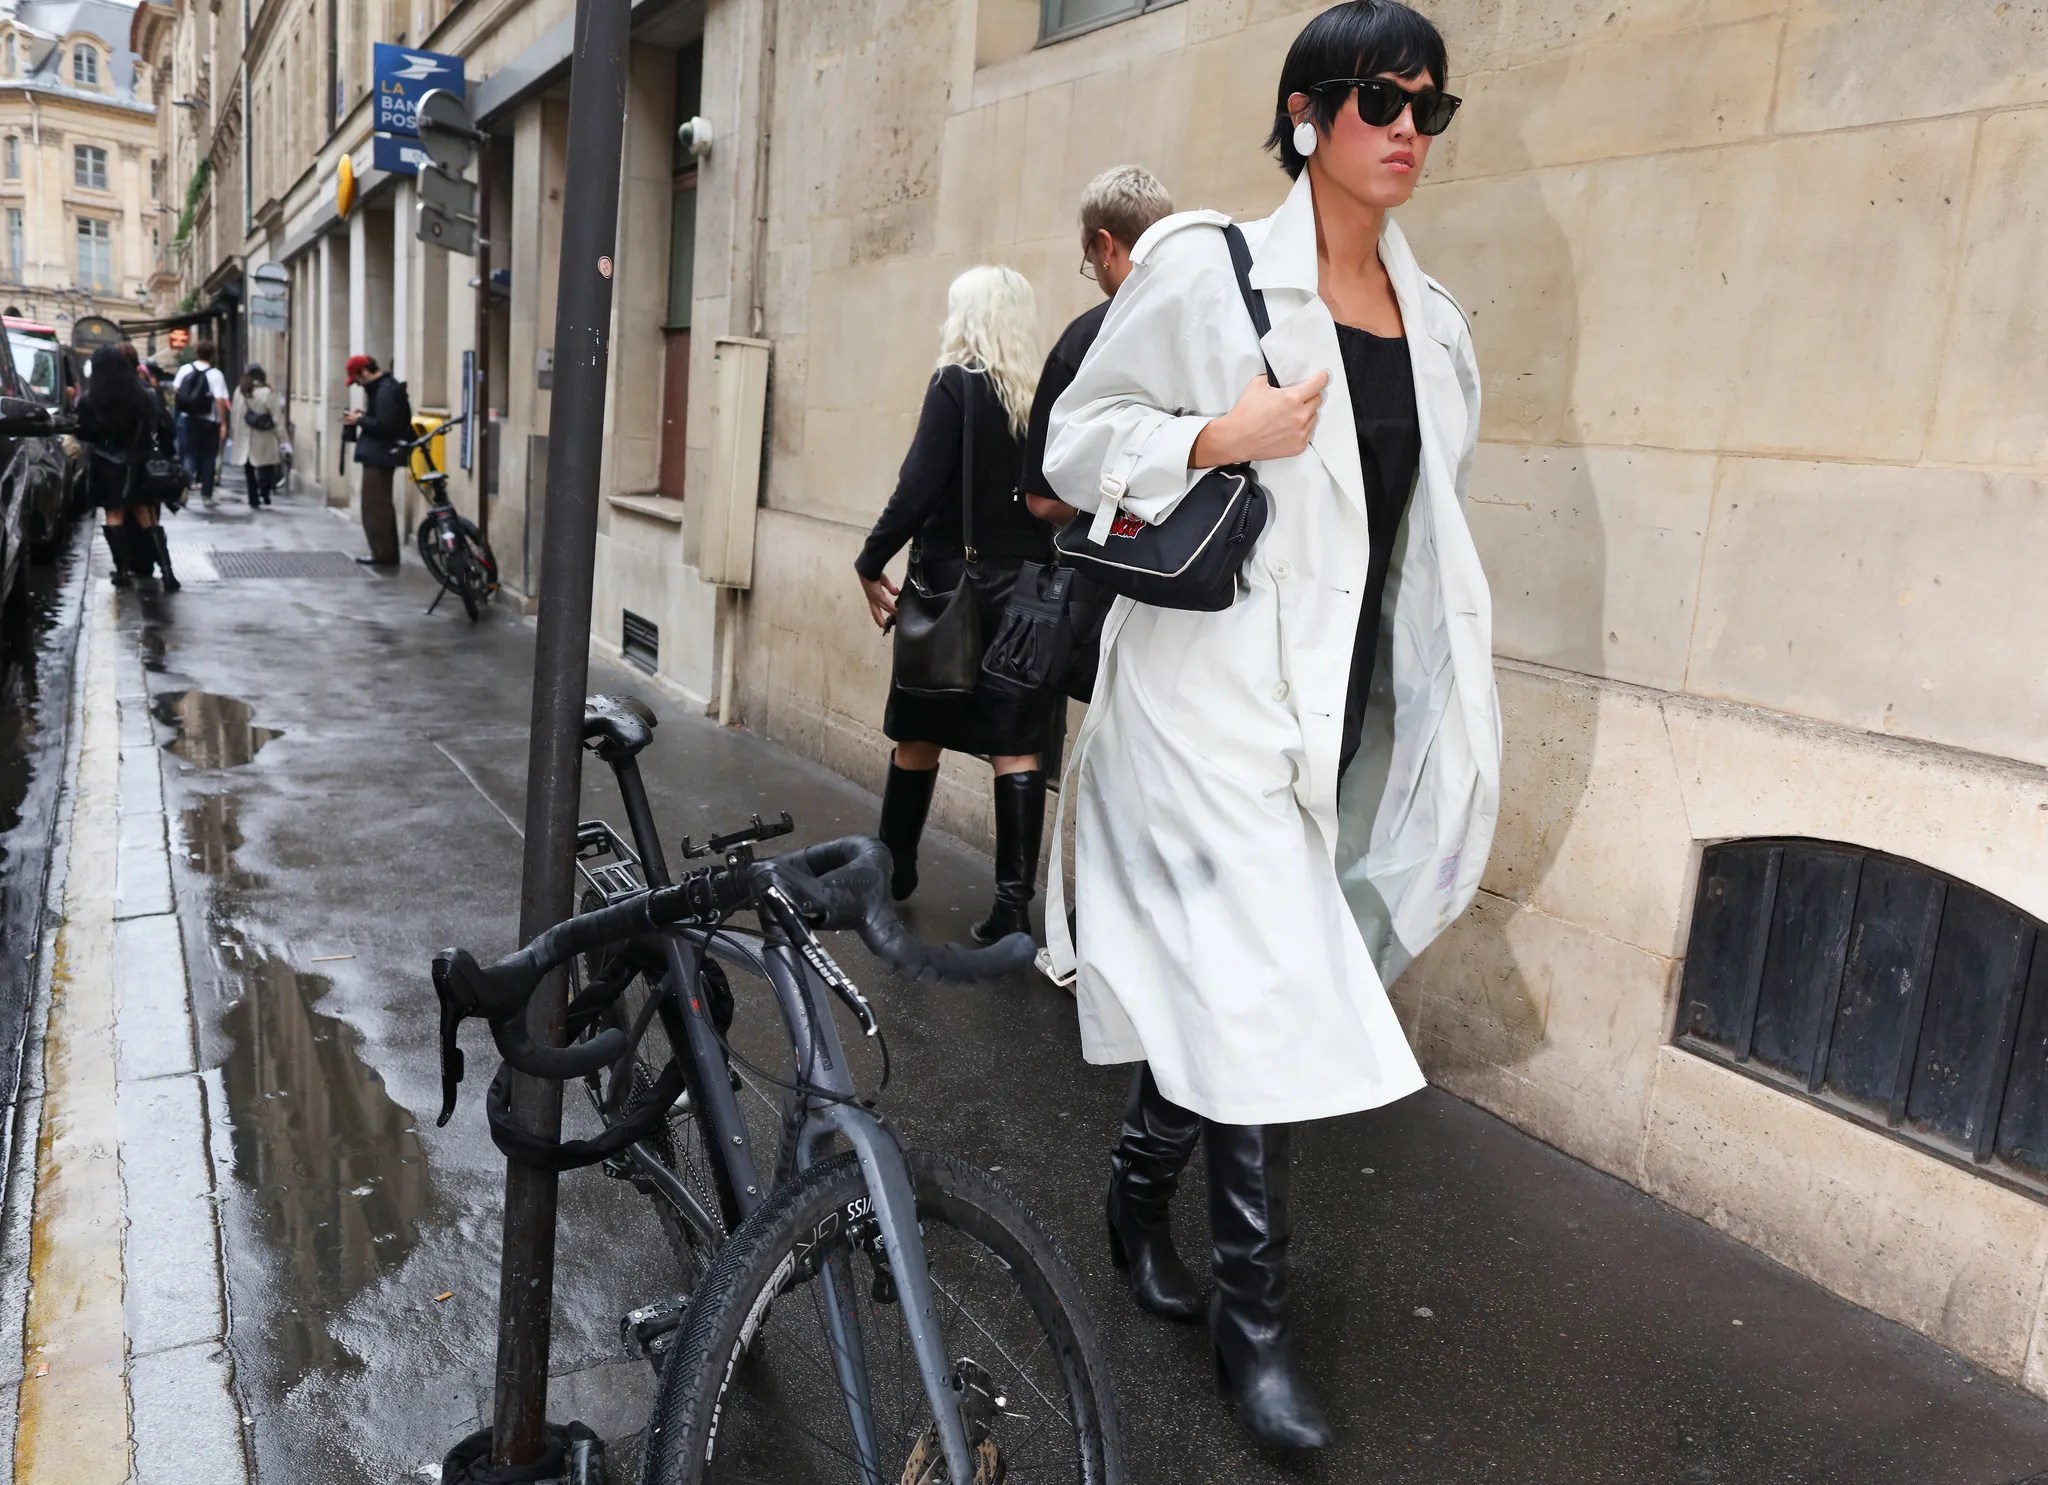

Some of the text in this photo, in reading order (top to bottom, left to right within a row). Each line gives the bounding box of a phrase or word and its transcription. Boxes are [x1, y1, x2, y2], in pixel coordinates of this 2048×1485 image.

[381, 80, 405, 96] LA
[381, 95, 418, 113] BAN
[801, 944, 839, 987] SRAM
[847, 1196, 875, 1222] ISS
